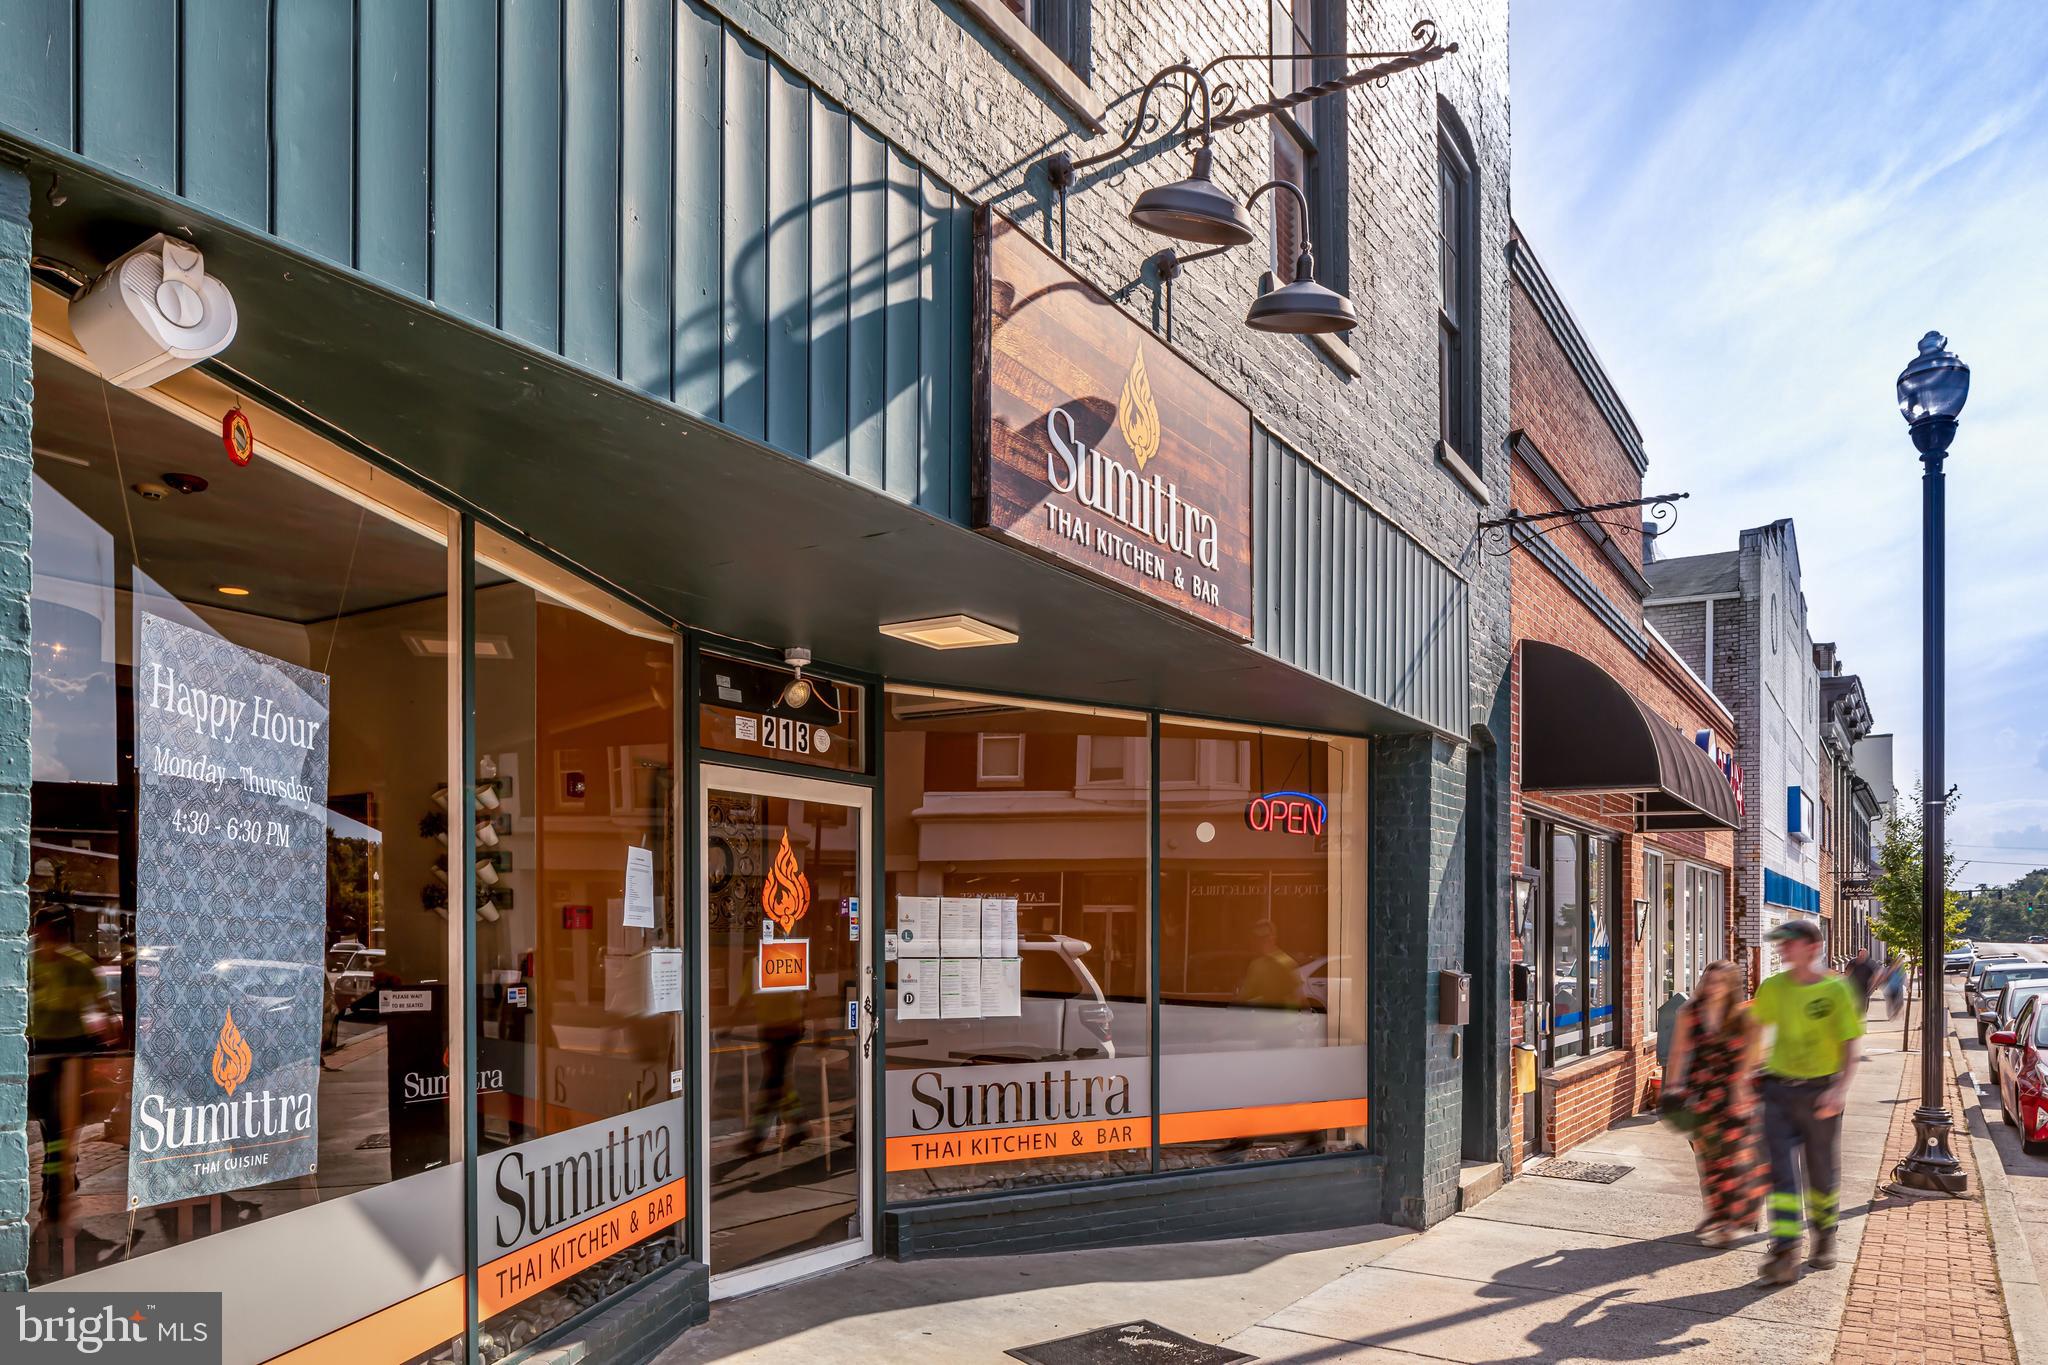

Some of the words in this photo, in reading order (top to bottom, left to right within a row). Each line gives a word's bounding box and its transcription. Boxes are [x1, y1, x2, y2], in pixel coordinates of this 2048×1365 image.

[1047, 407, 1220, 572] Sumittra
[1045, 502, 1091, 547] THAI
[1096, 527, 1165, 581] KITCHEN
[1173, 566, 1185, 590] &
[1192, 575, 1220, 607] BAR
[149, 662, 246, 743] Happy
[250, 695, 320, 751] Hour
[764, 717, 808, 752] 213
[153, 745, 226, 792] Monday
[239, 765, 313, 809] Thursday
[172, 808, 209, 836] 4:30
[227, 817, 262, 844] 6:30
[265, 822, 291, 848] PM
[1250, 798, 1322, 835] OPEN
[765, 958, 804, 975] OPEN
[140, 1090, 312, 1153] Sumittra
[911, 1070, 1132, 1131] Sumittra
[193, 1160, 221, 1176] THAI
[224, 1153, 269, 1171] CUISINE
[911, 1140, 962, 1161] THAI
[971, 1132, 1057, 1156] KITCHEN
[1071, 1130, 1083, 1146] &
[1097, 1126, 1132, 1144] BAR
[495, 1123, 672, 1248] Sumittra
[496, 1253, 542, 1298] THAI
[550, 1217, 620, 1274] KITCHEN
[630, 1210, 639, 1234] &
[649, 1193, 673, 1225] BAR
